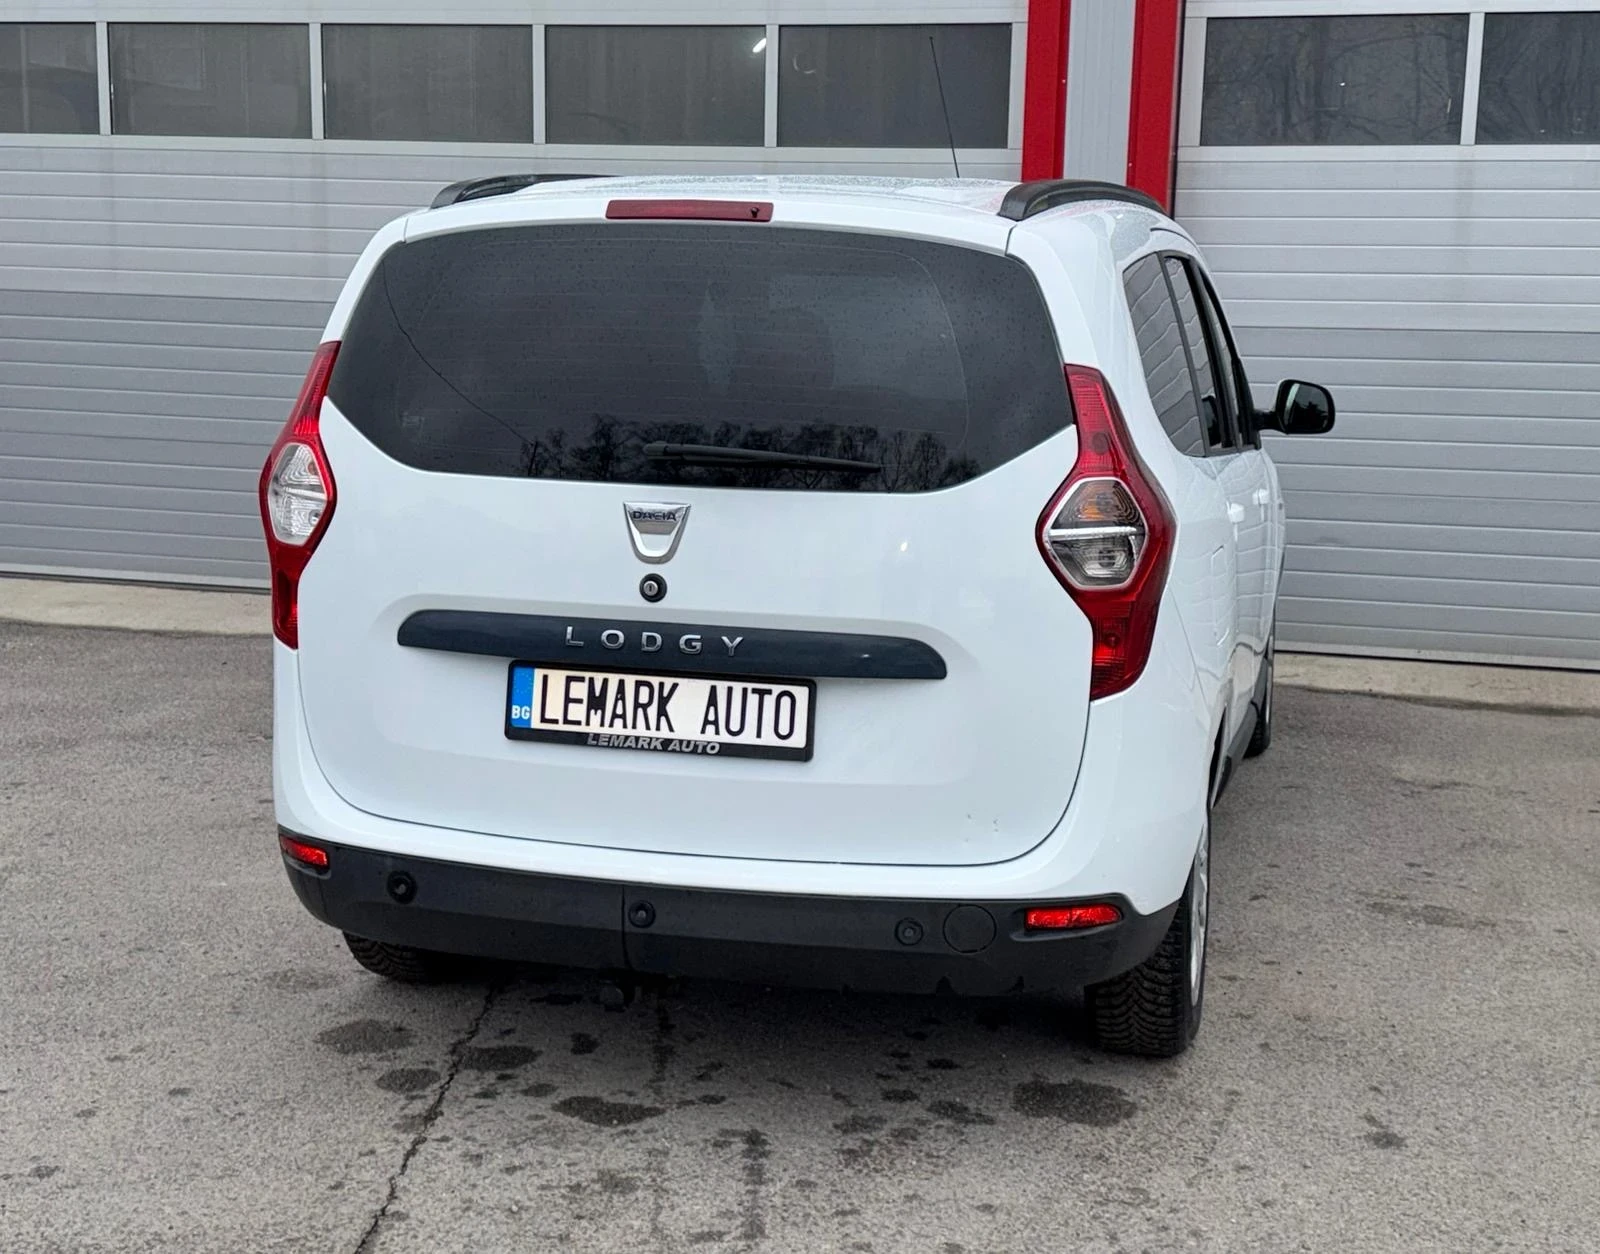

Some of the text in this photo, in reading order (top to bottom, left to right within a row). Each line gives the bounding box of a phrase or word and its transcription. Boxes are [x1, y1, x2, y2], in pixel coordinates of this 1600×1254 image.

[632, 510, 677, 521] DACIA
[565, 626, 744, 657] LODGY
[511, 704, 531, 720] BG
[540, 674, 797, 740] LEMARK AUTO
[587, 732, 721, 755] LEMARK AUTO
